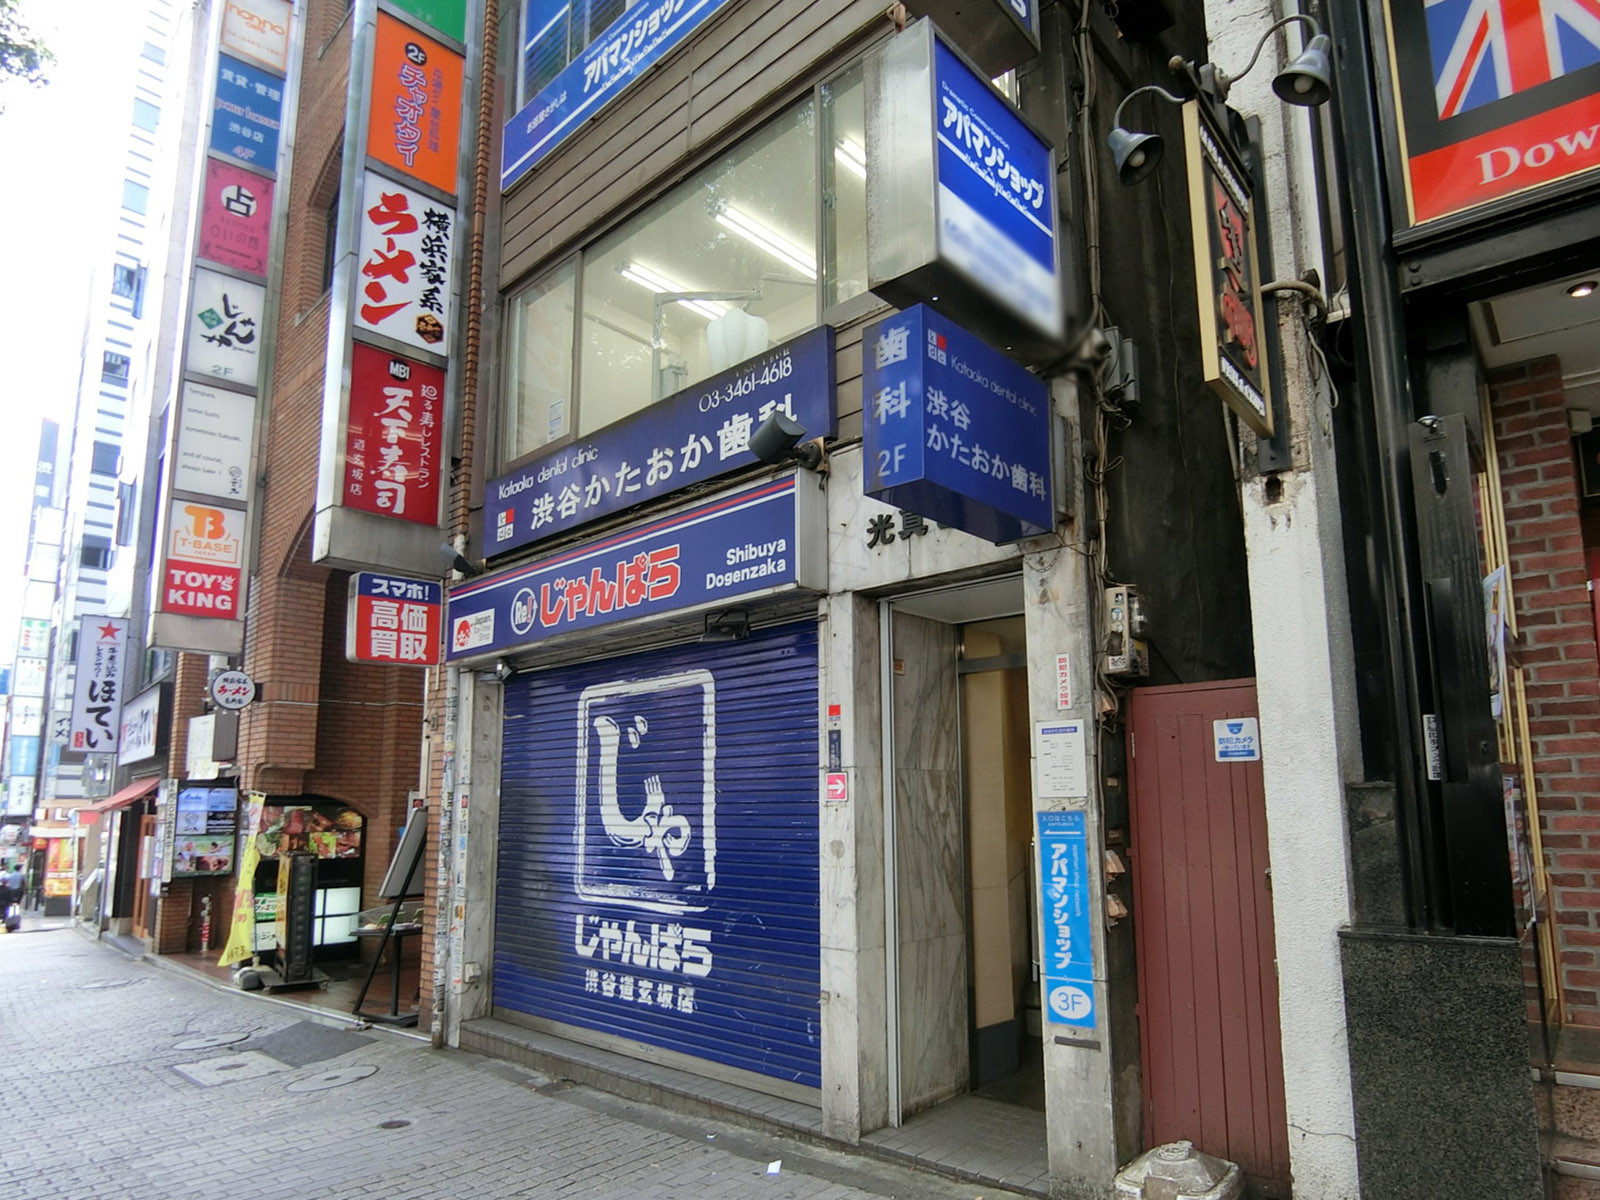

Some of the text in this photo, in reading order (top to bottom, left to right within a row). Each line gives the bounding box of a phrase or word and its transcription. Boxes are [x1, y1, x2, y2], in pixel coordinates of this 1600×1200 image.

[407, 45, 426, 64] 2F
[395, 64, 428, 167] チャオタイ
[232, 145, 257, 160] 4F
[942, 95, 1045, 209] アパマンショップ
[225, 185, 255, 217] 占
[361, 192, 418, 325] ラーメン
[420, 207, 451, 315] 横浜家系
[211, 364, 235, 376] 2F
[699, 357, 793, 412] 03-3461-4618
[874, 326, 911, 425] 歯科
[951, 354, 989, 388] Kataoka
[990, 382, 1017, 404] dental
[926, 385, 972, 431] 渋谷
[350, 438, 366, 496] 道玄坂店
[371, 387, 413, 514] 天下寿司
[499, 444, 599, 500] Kataoka dental clinic
[878, 443, 907, 477] 2F
[926, 423, 1047, 501] かたおか歯科
[706, 558, 786, 590] Dogenzaka
[726, 537, 786, 566] Shibuya
[168, 589, 232, 610] KING
[170, 569, 235, 591] TOY'S
[540, 544, 680, 627] じゃんぱら
[371, 600, 428, 632] 高価
[370, 630, 427, 661] 買取
[86, 680, 116, 749] ほてい
[1051, 843, 1072, 969] アパマンショップ
[575, 915, 713, 977] じゃんぱら
[1057, 991, 1083, 1012] 3F
